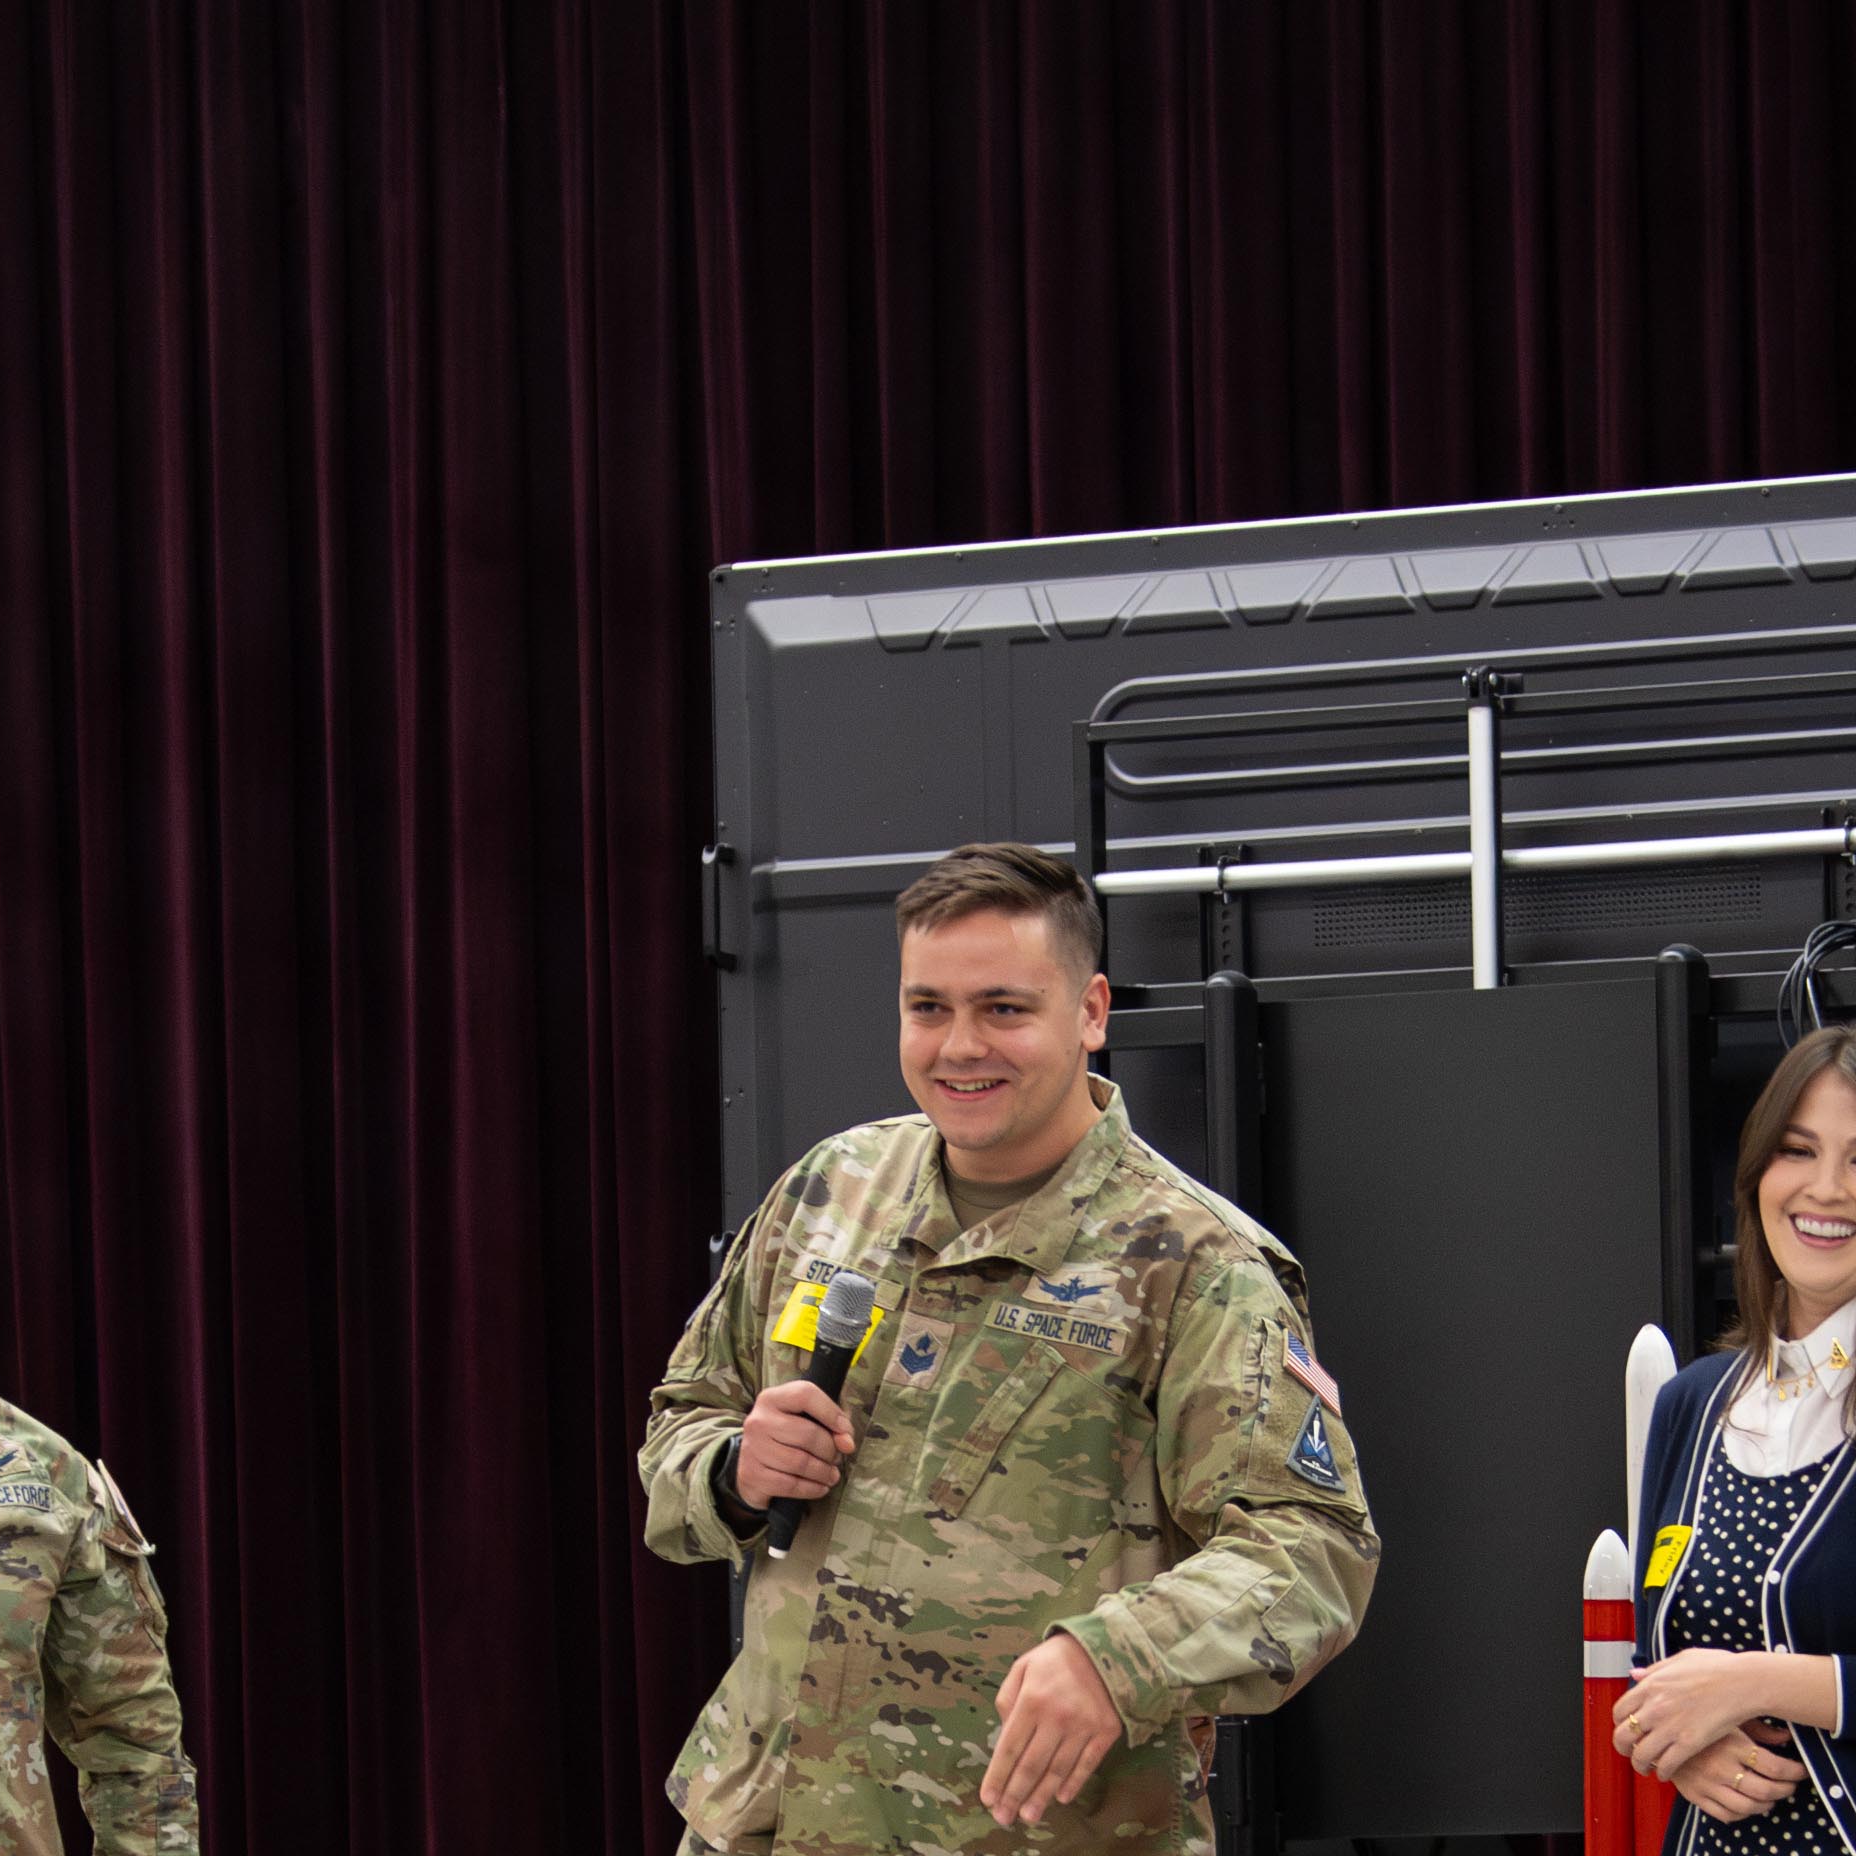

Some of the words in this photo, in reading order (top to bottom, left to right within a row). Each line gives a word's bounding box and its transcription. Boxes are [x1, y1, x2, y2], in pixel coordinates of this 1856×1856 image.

[994, 1305, 1019, 1330] U.S.
[1023, 1312, 1067, 1339] SPACE
[1068, 1320, 1118, 1351] FORCE
[13, 1484, 50, 1509] FORCE
